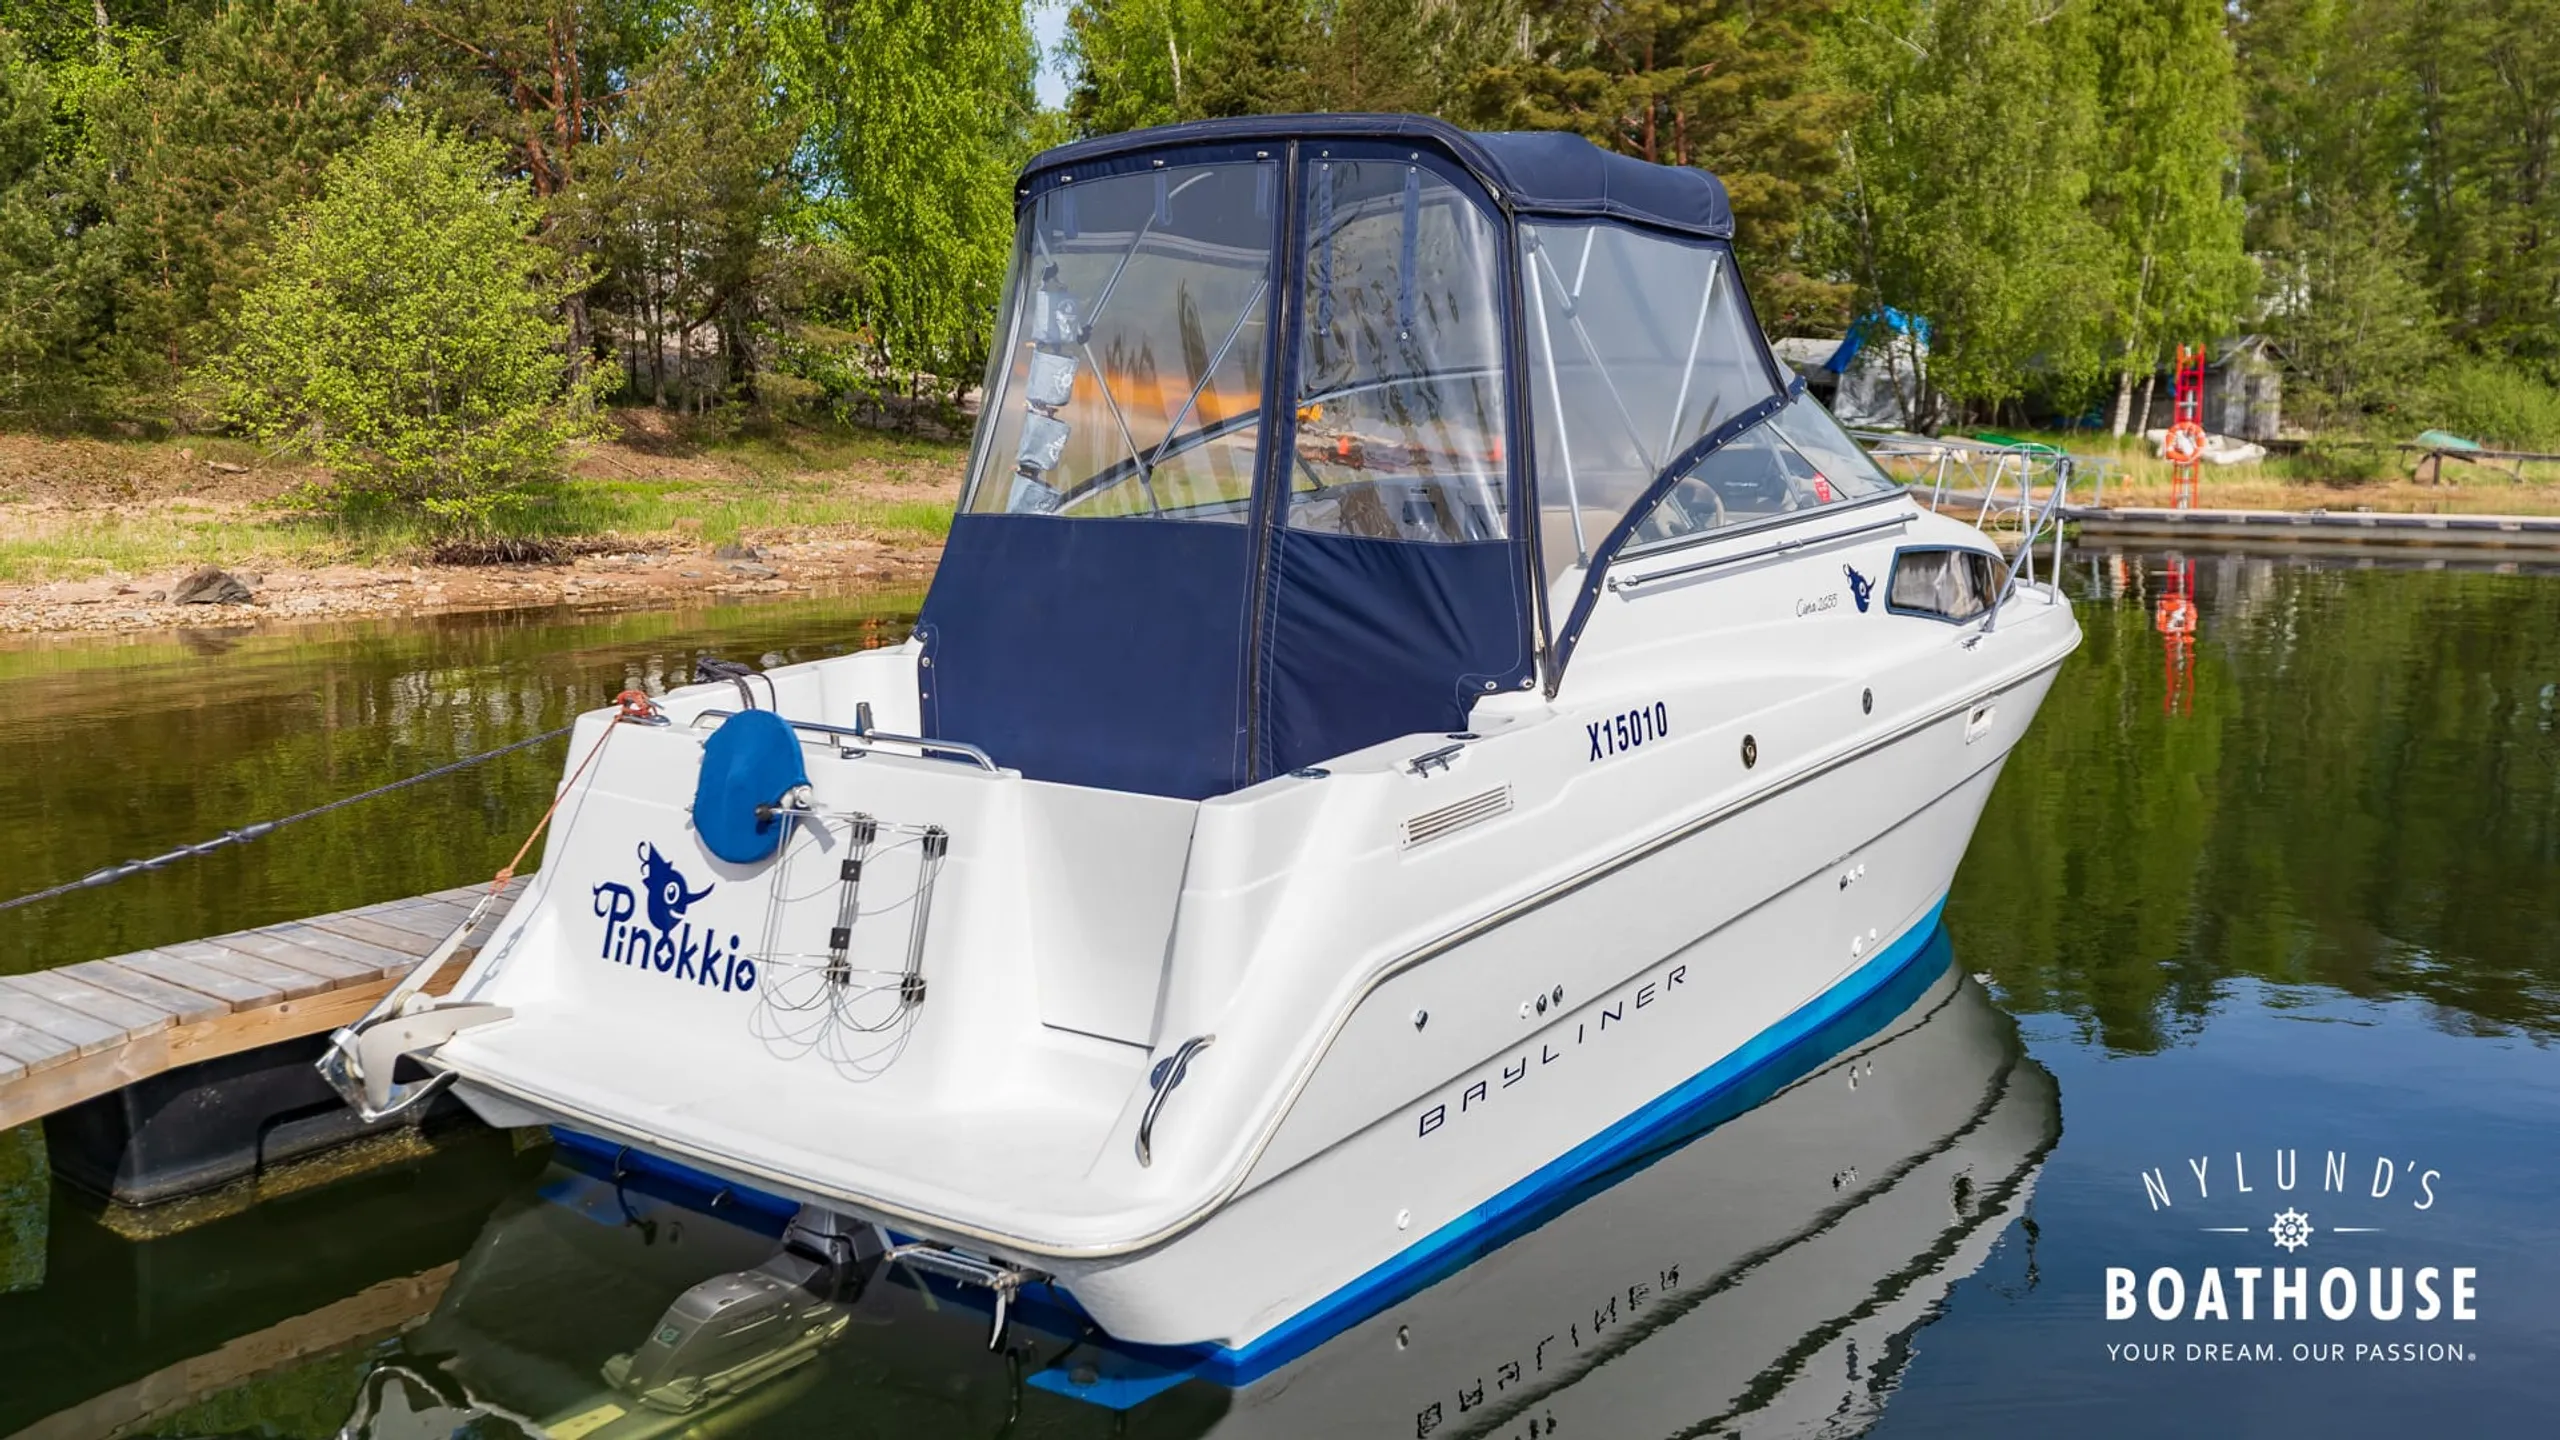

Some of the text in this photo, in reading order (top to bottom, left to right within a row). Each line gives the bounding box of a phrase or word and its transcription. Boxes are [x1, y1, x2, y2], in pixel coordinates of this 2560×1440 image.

[1586, 701, 1668, 762] X15010
[593, 881, 757, 993] Pinokkio
[1418, 965, 1687, 1138] BAYLINER
